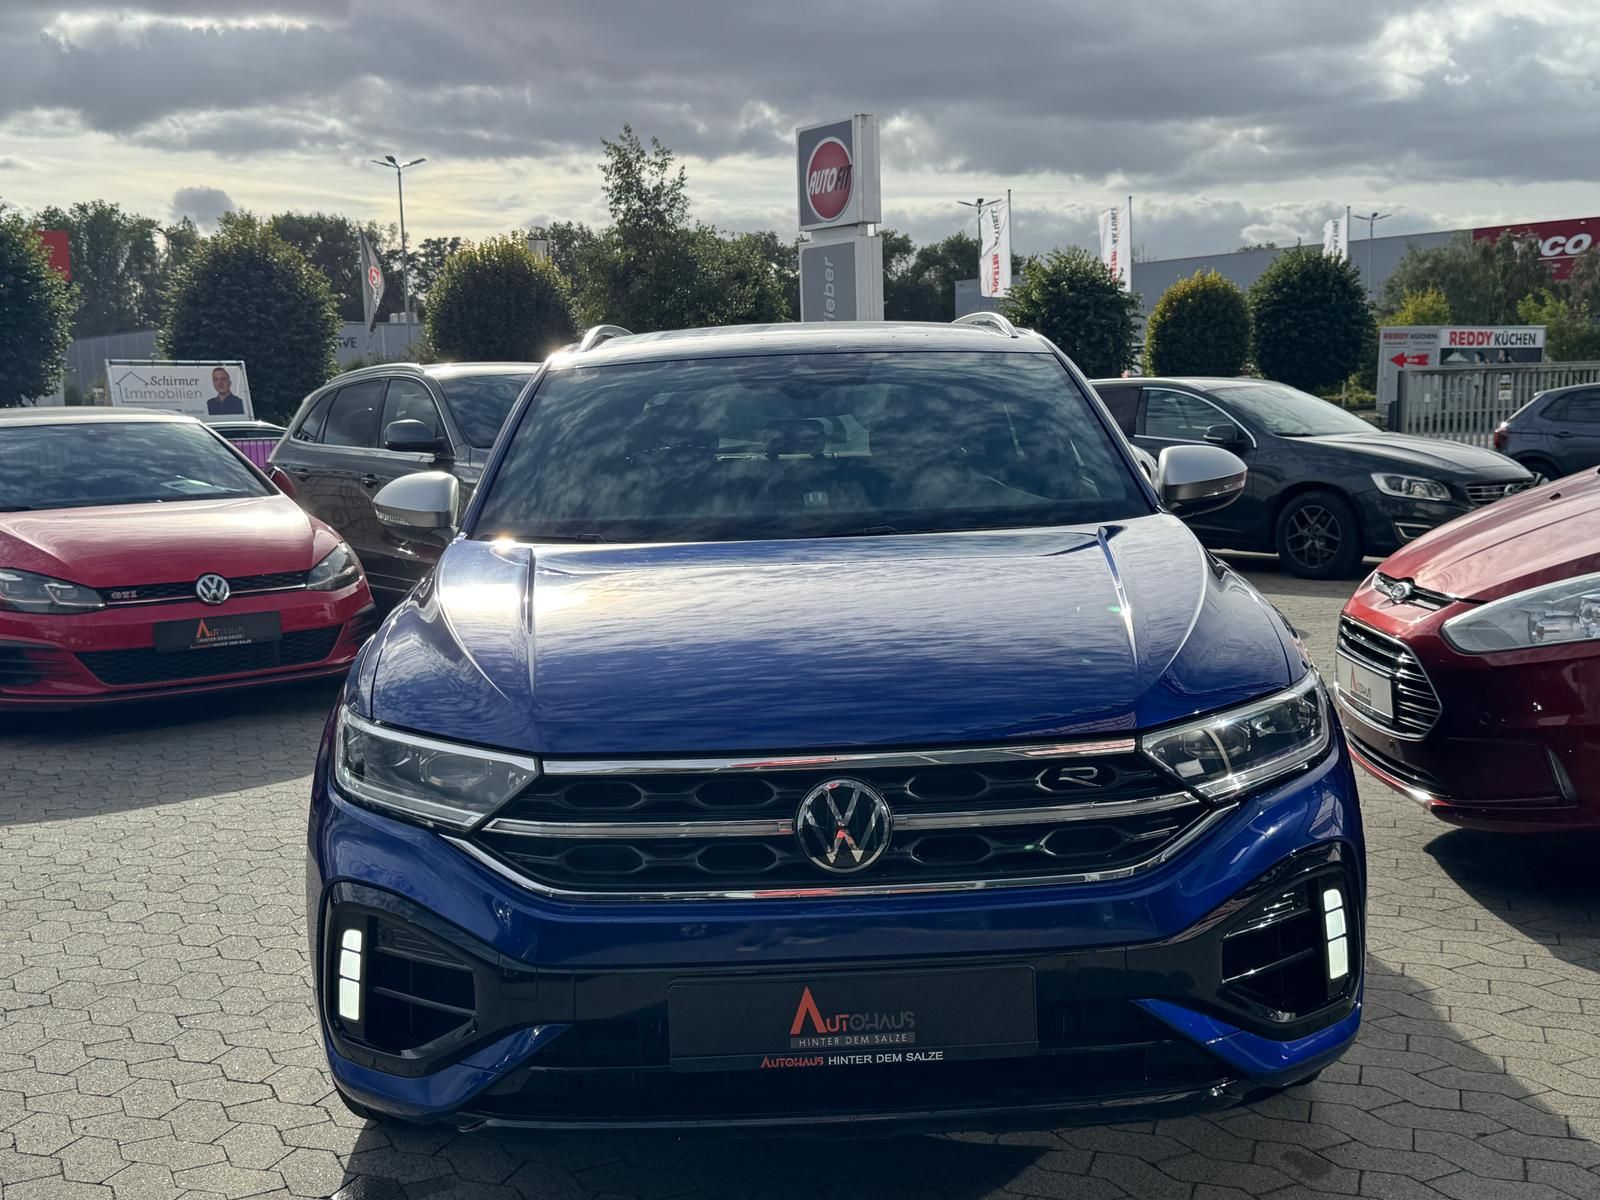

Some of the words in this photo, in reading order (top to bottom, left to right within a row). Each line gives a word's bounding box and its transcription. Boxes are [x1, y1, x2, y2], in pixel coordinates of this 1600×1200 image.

[809, 164, 853, 196] AUTOFIT
[1449, 331, 1494, 346] REDDY
[1494, 330, 1537, 346] KÜCHEN
[150, 375, 200, 386] Schirmer
[123, 388, 203, 400] Immobilien
[111, 590, 138, 600] GTI
[799, 1036, 840, 1047] HINTER
[845, 1035, 870, 1045] DEM
[875, 1033, 908, 1043] SALZE
[828, 1054, 873, 1065] HINTER
[876, 1053, 902, 1063] DEM
[906, 1050, 944, 1062] SALZE
